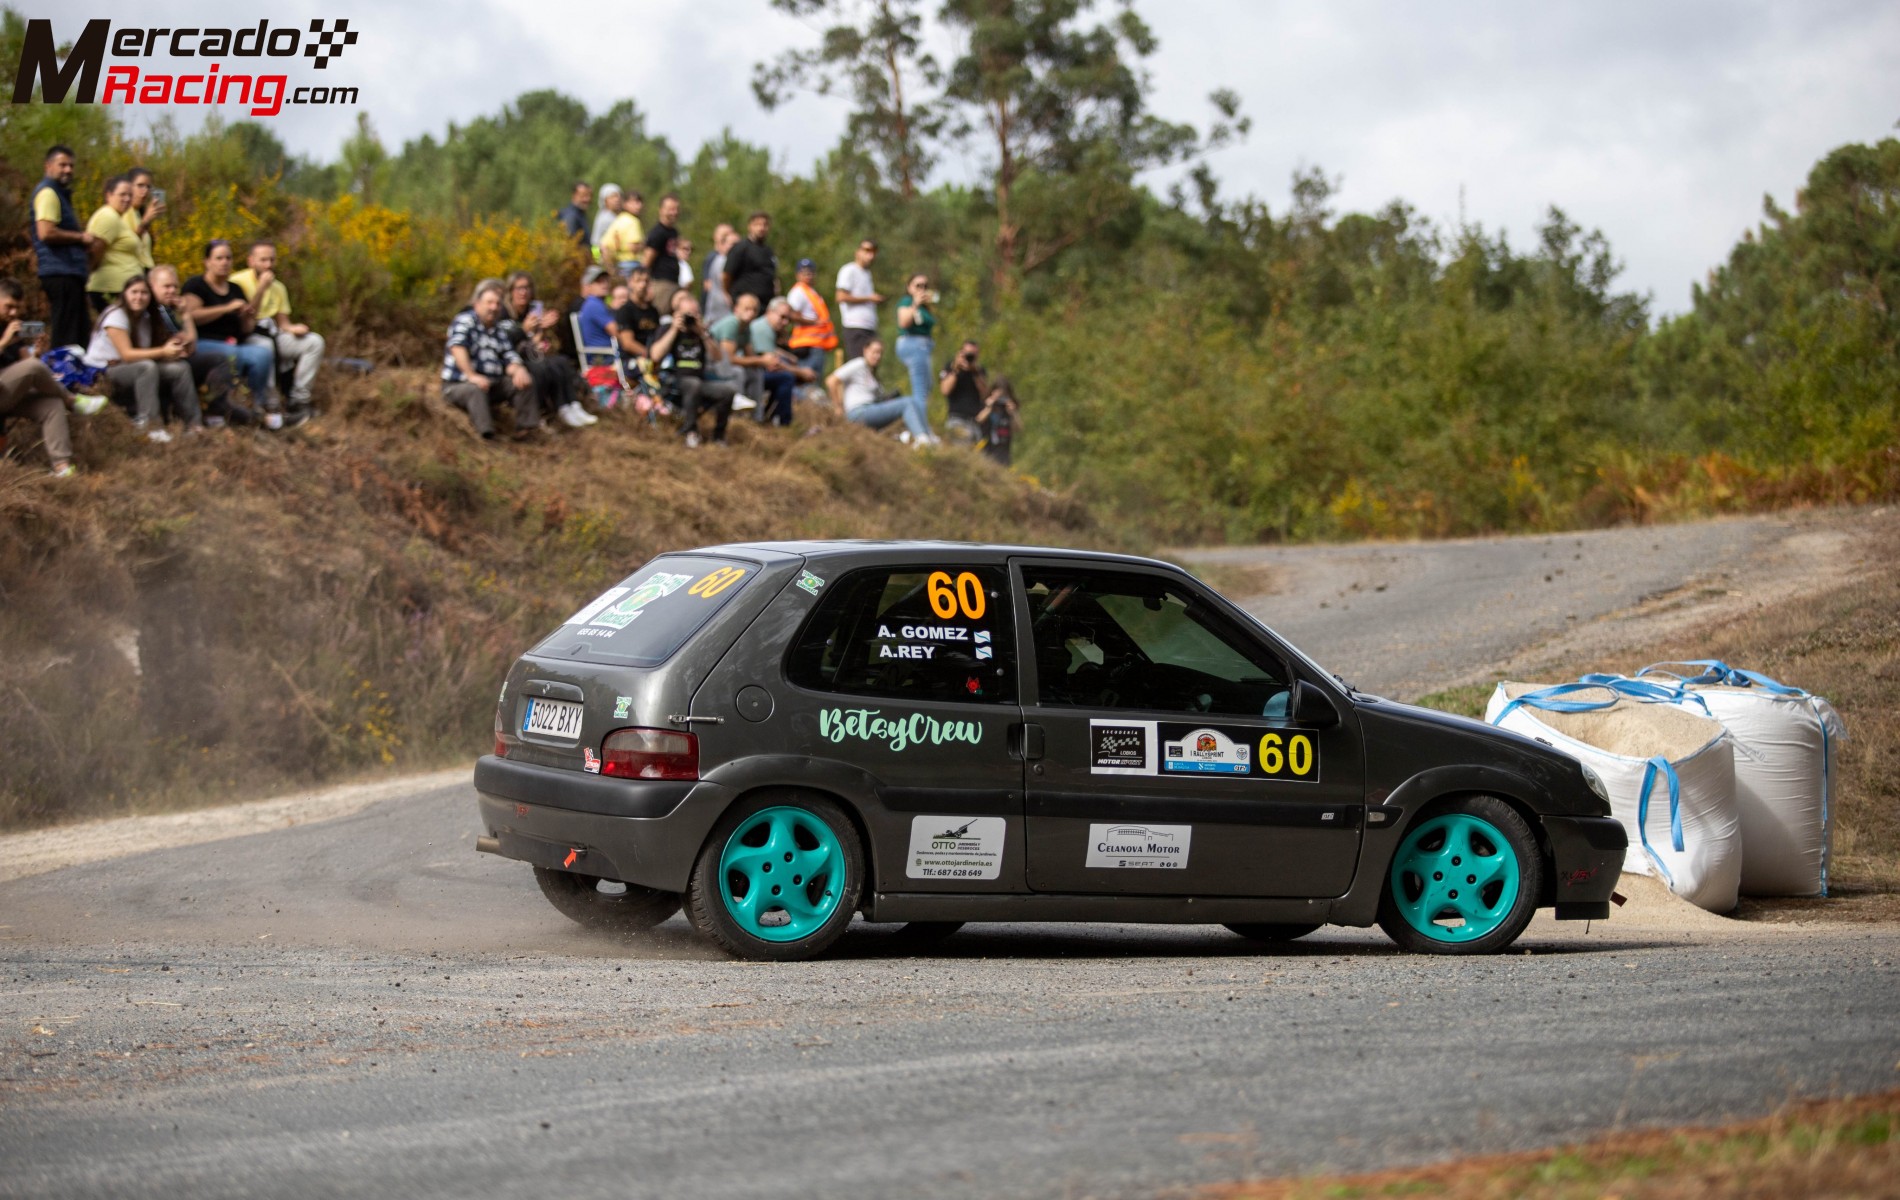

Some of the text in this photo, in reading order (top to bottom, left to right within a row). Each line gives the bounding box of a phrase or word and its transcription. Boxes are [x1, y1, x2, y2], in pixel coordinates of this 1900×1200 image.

[688, 566, 745, 599] 60
[927, 571, 986, 620] 60
[877, 625, 968, 641] A. GOMEZ
[879, 645, 936, 660] A.REY
[531, 702, 583, 734] 5022 BXY
[819, 708, 983, 753] BetsyCrew
[1258, 733, 1313, 776] 60
[931, 841, 957, 850] OTTO
[952, 869, 967, 877] 628
[967, 869, 983, 877] 649
